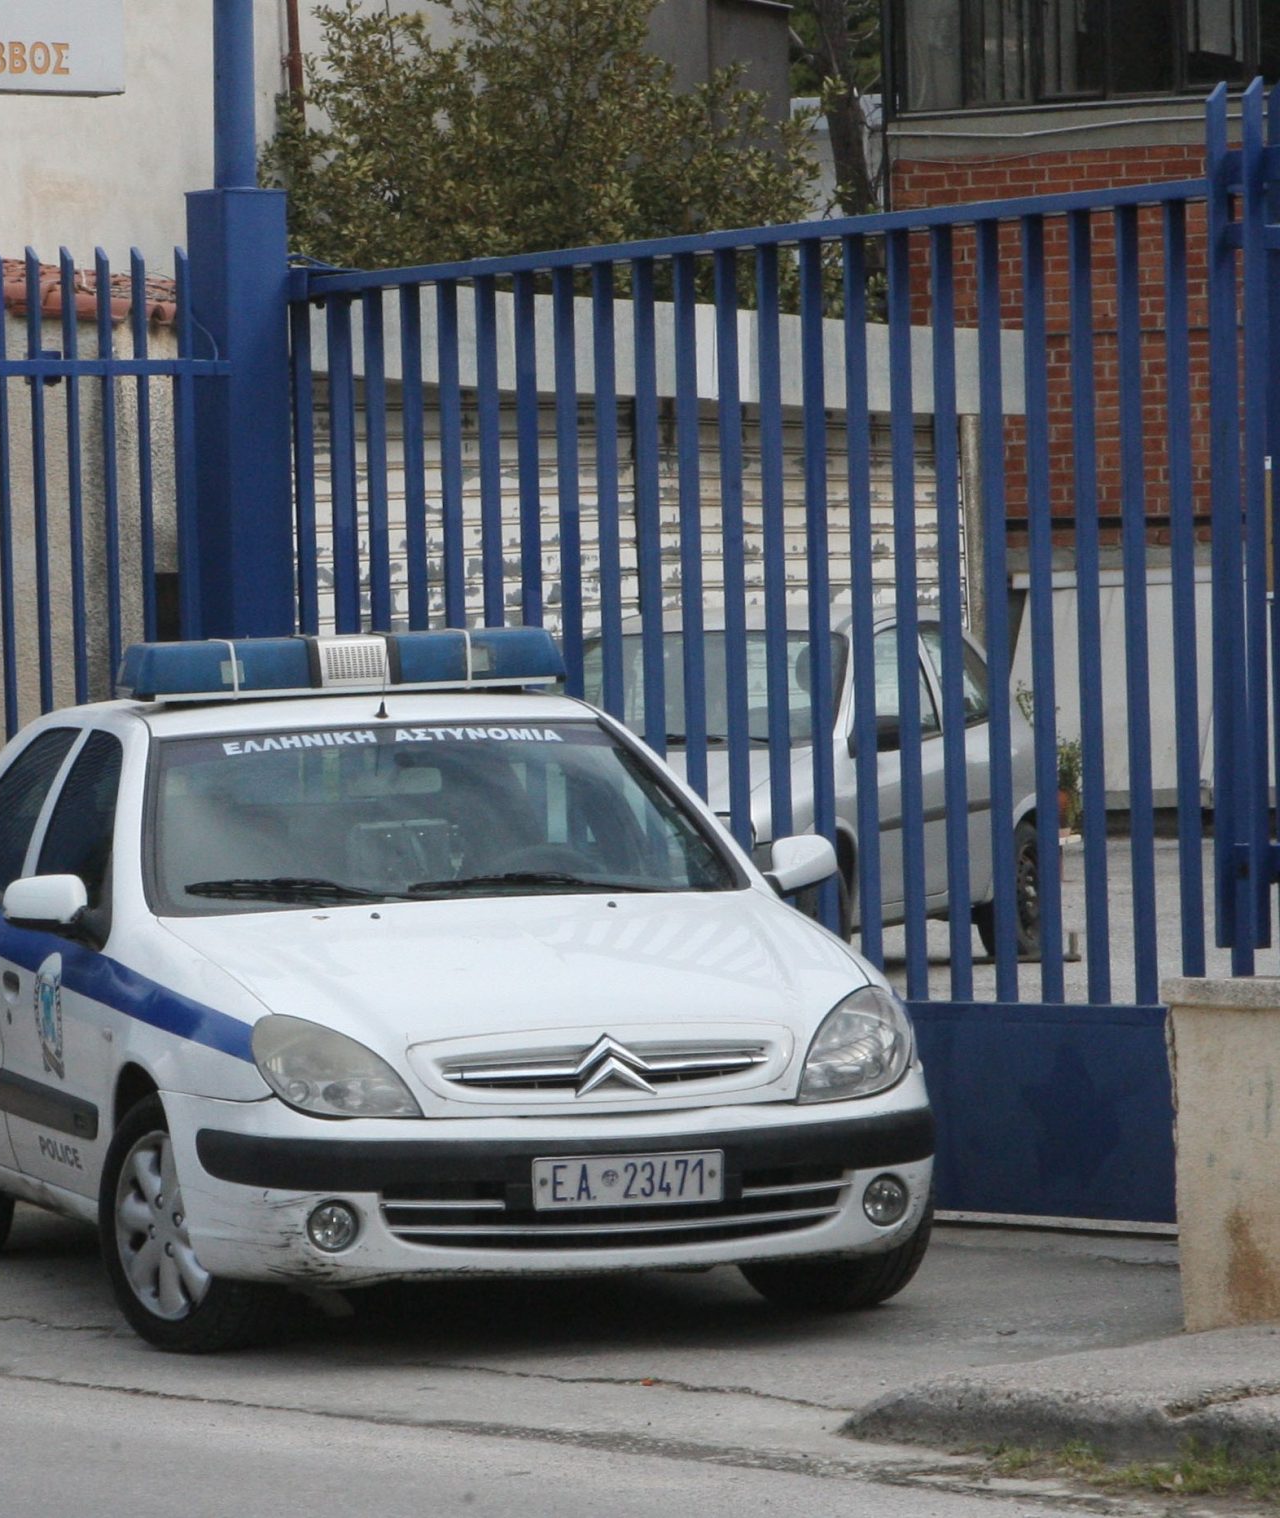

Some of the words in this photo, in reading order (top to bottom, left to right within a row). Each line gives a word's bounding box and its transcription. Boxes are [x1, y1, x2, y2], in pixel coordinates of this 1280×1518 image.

[223, 730, 377, 756] ΕΛΛΗΝΙΚΗ
[395, 727, 564, 743] ΑΣΤΥΝΟΜΙΑ
[38, 1135, 84, 1170] POLICE
[623, 1158, 705, 1199] 23471
